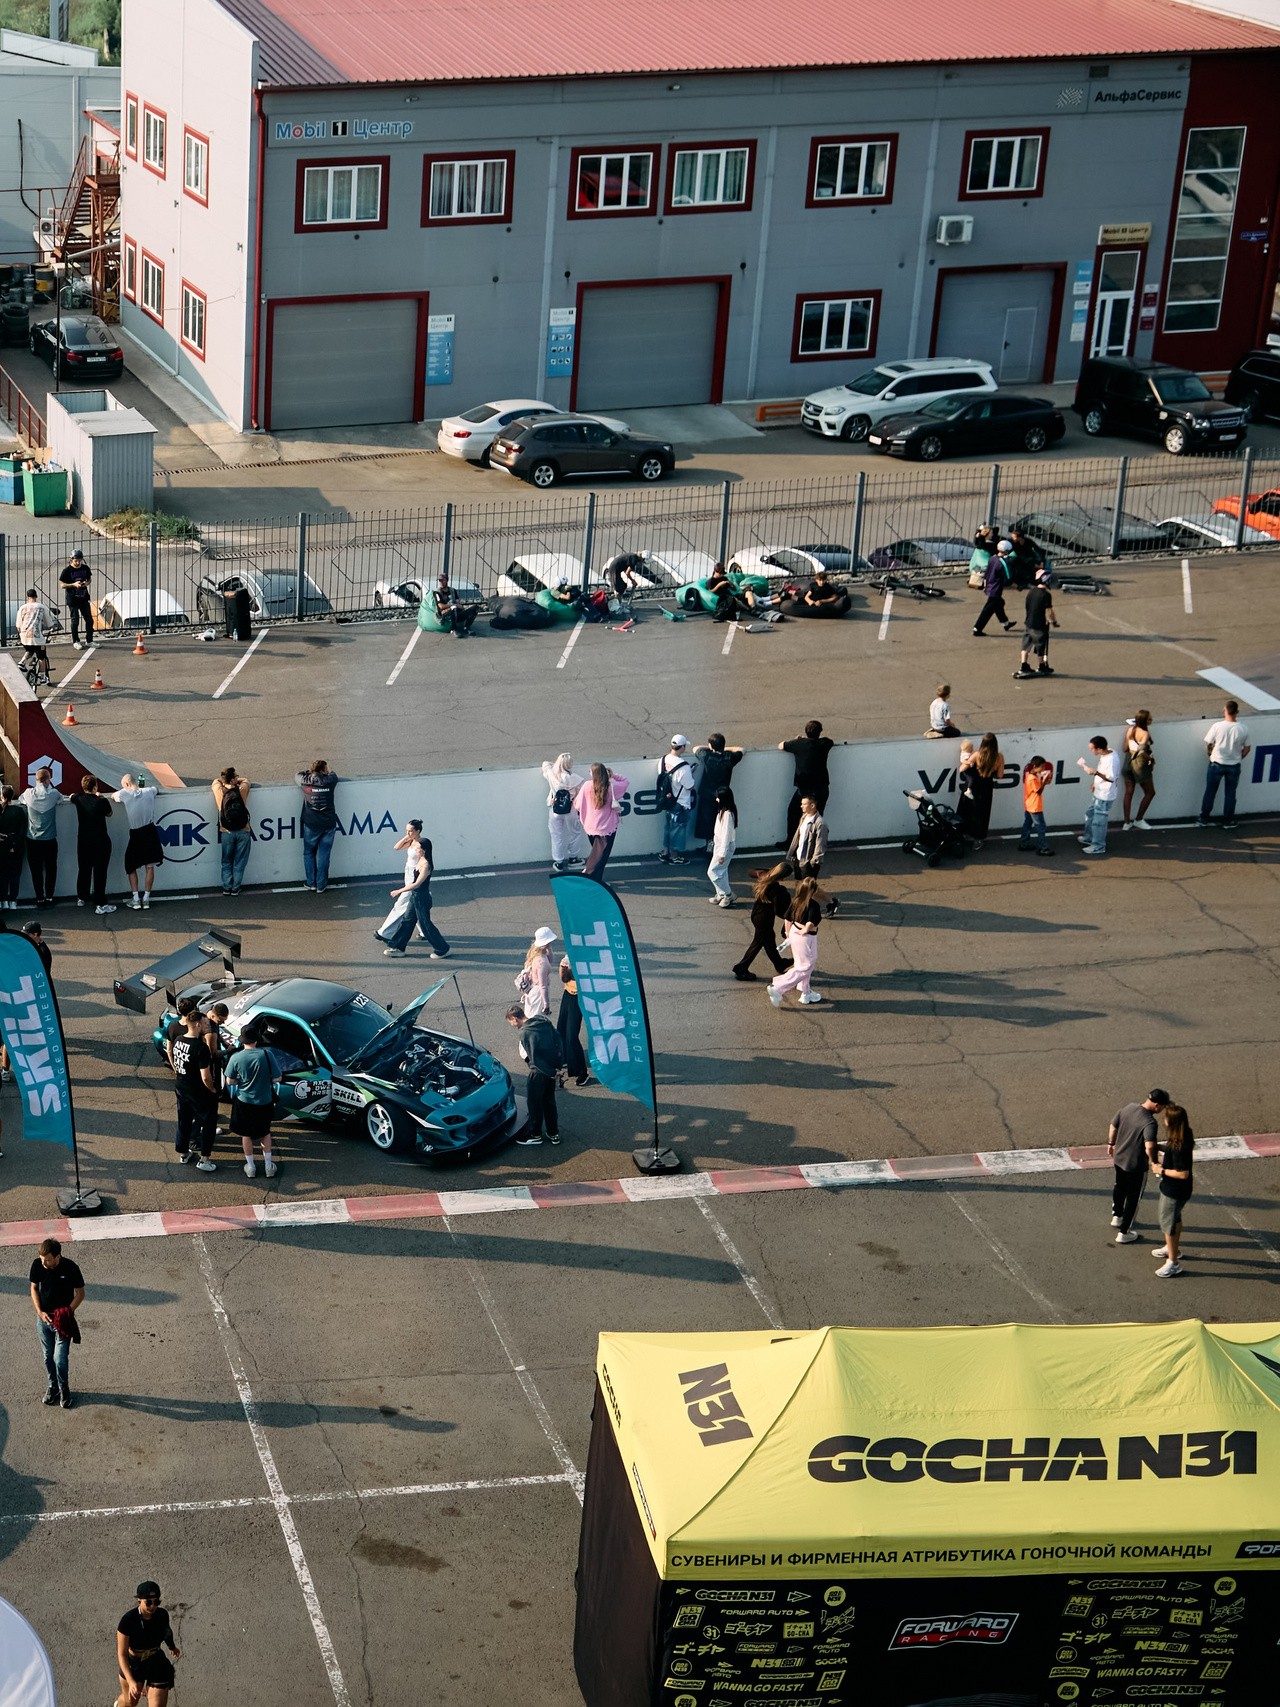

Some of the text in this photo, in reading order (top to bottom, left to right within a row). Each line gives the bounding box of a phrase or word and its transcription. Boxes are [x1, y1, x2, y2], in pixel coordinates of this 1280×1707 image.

[1095, 88, 1182, 103] АльфаСервис
[276, 119, 413, 139] Mobil 1 Центр
[570, 921, 630, 1065] SKILL
[610, 921, 642, 1063] FORGED WHEELS
[353, 994, 370, 1008] 123
[35, 970, 69, 1108] FORGED WHEELS
[0, 975, 62, 1117] SKILL
[173, 1041, 190, 1053] ANTI
[333, 1088, 362, 1103] SKILL
[678, 1362, 754, 1447] N31
[808, 1430, 1258, 1483] GOCHA N31
[671, 1543, 1212, 1567] СУВЕНИРЫ И ФИРМЕННАЯ АТРИБУТИКА ГОНОЧНОЙ КОМАНДЫ
[695, 1589, 748, 1602] GOCHA
[1156, 1595, 1183, 1603] AUTO
[901, 1617, 1010, 1635] FORWARD
[1094, 1616, 1105, 1626] 31
[706, 1628, 717, 1638] 31
[901, 1630, 999, 1643] RACING
[1134, 1641, 1165, 1651] N31
[751, 1658, 781, 1668] N31
[815, 1658, 848, 1666] GOCHA
[1097, 1667, 1187, 1678] WANNA GO FAST!
[713, 1681, 804, 1692] WANNA GO FAST!
[1125, 1685, 1180, 1695] GOCHA
